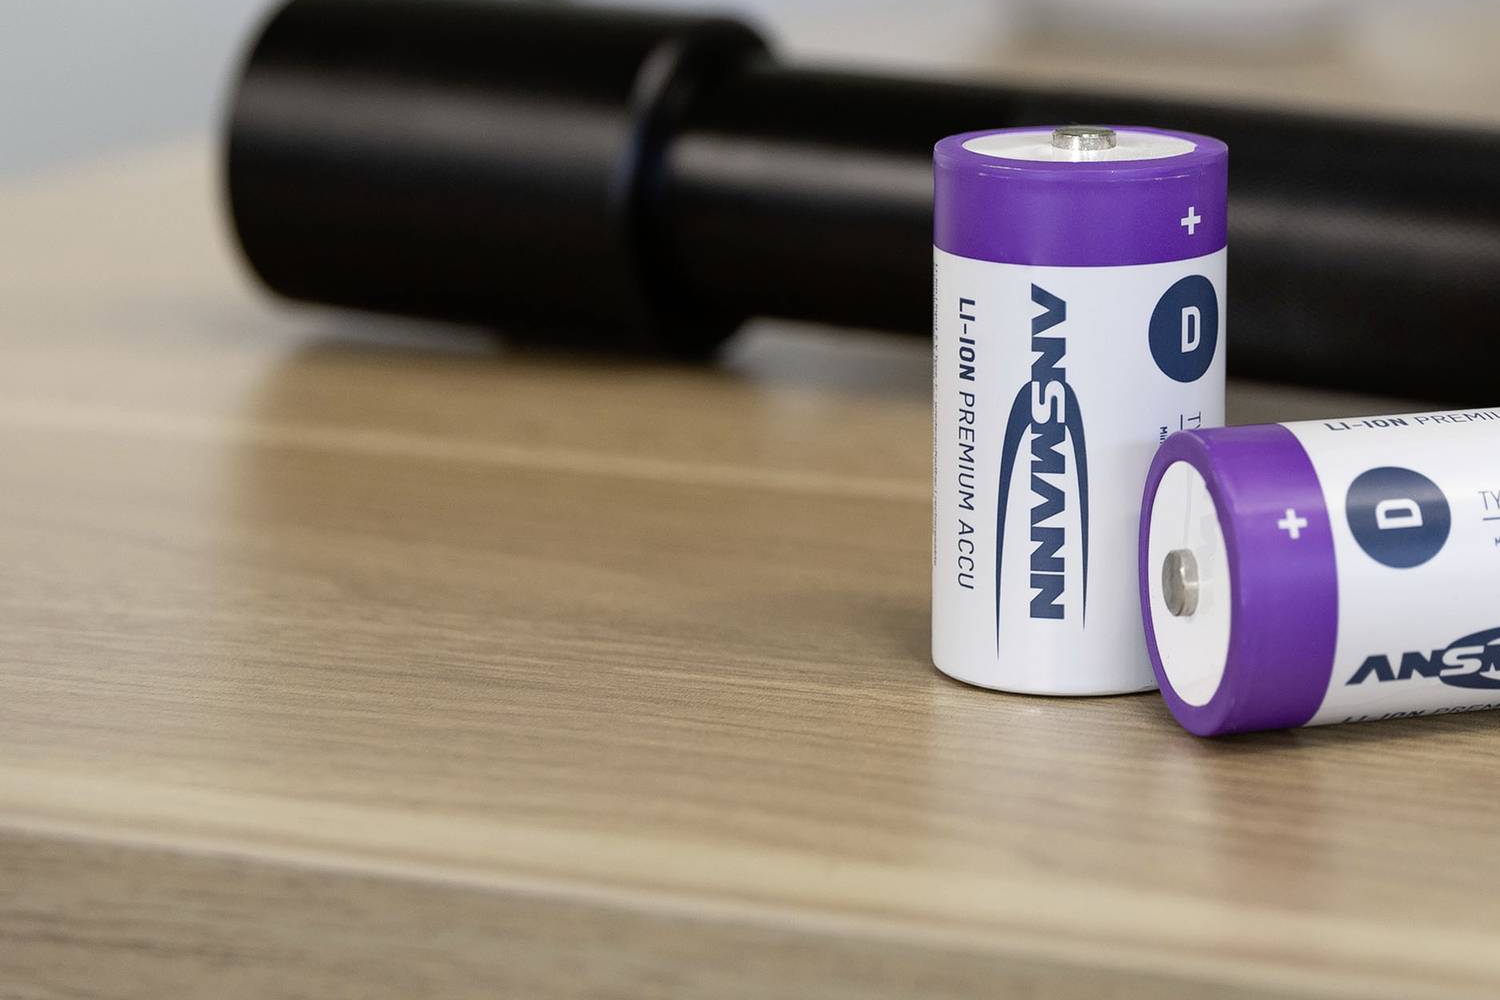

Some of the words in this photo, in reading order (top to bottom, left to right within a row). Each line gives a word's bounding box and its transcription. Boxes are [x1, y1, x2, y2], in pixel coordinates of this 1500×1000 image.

[959, 297, 976, 382] LI-ION
[1181, 306, 1201, 353] D
[958, 390, 975, 511] PREMIUM
[1029, 282, 1066, 620] ANSMANN
[1325, 418, 1410, 431] LI-ION
[1375, 498, 1424, 530] D
[957, 519, 975, 590] ACCU
